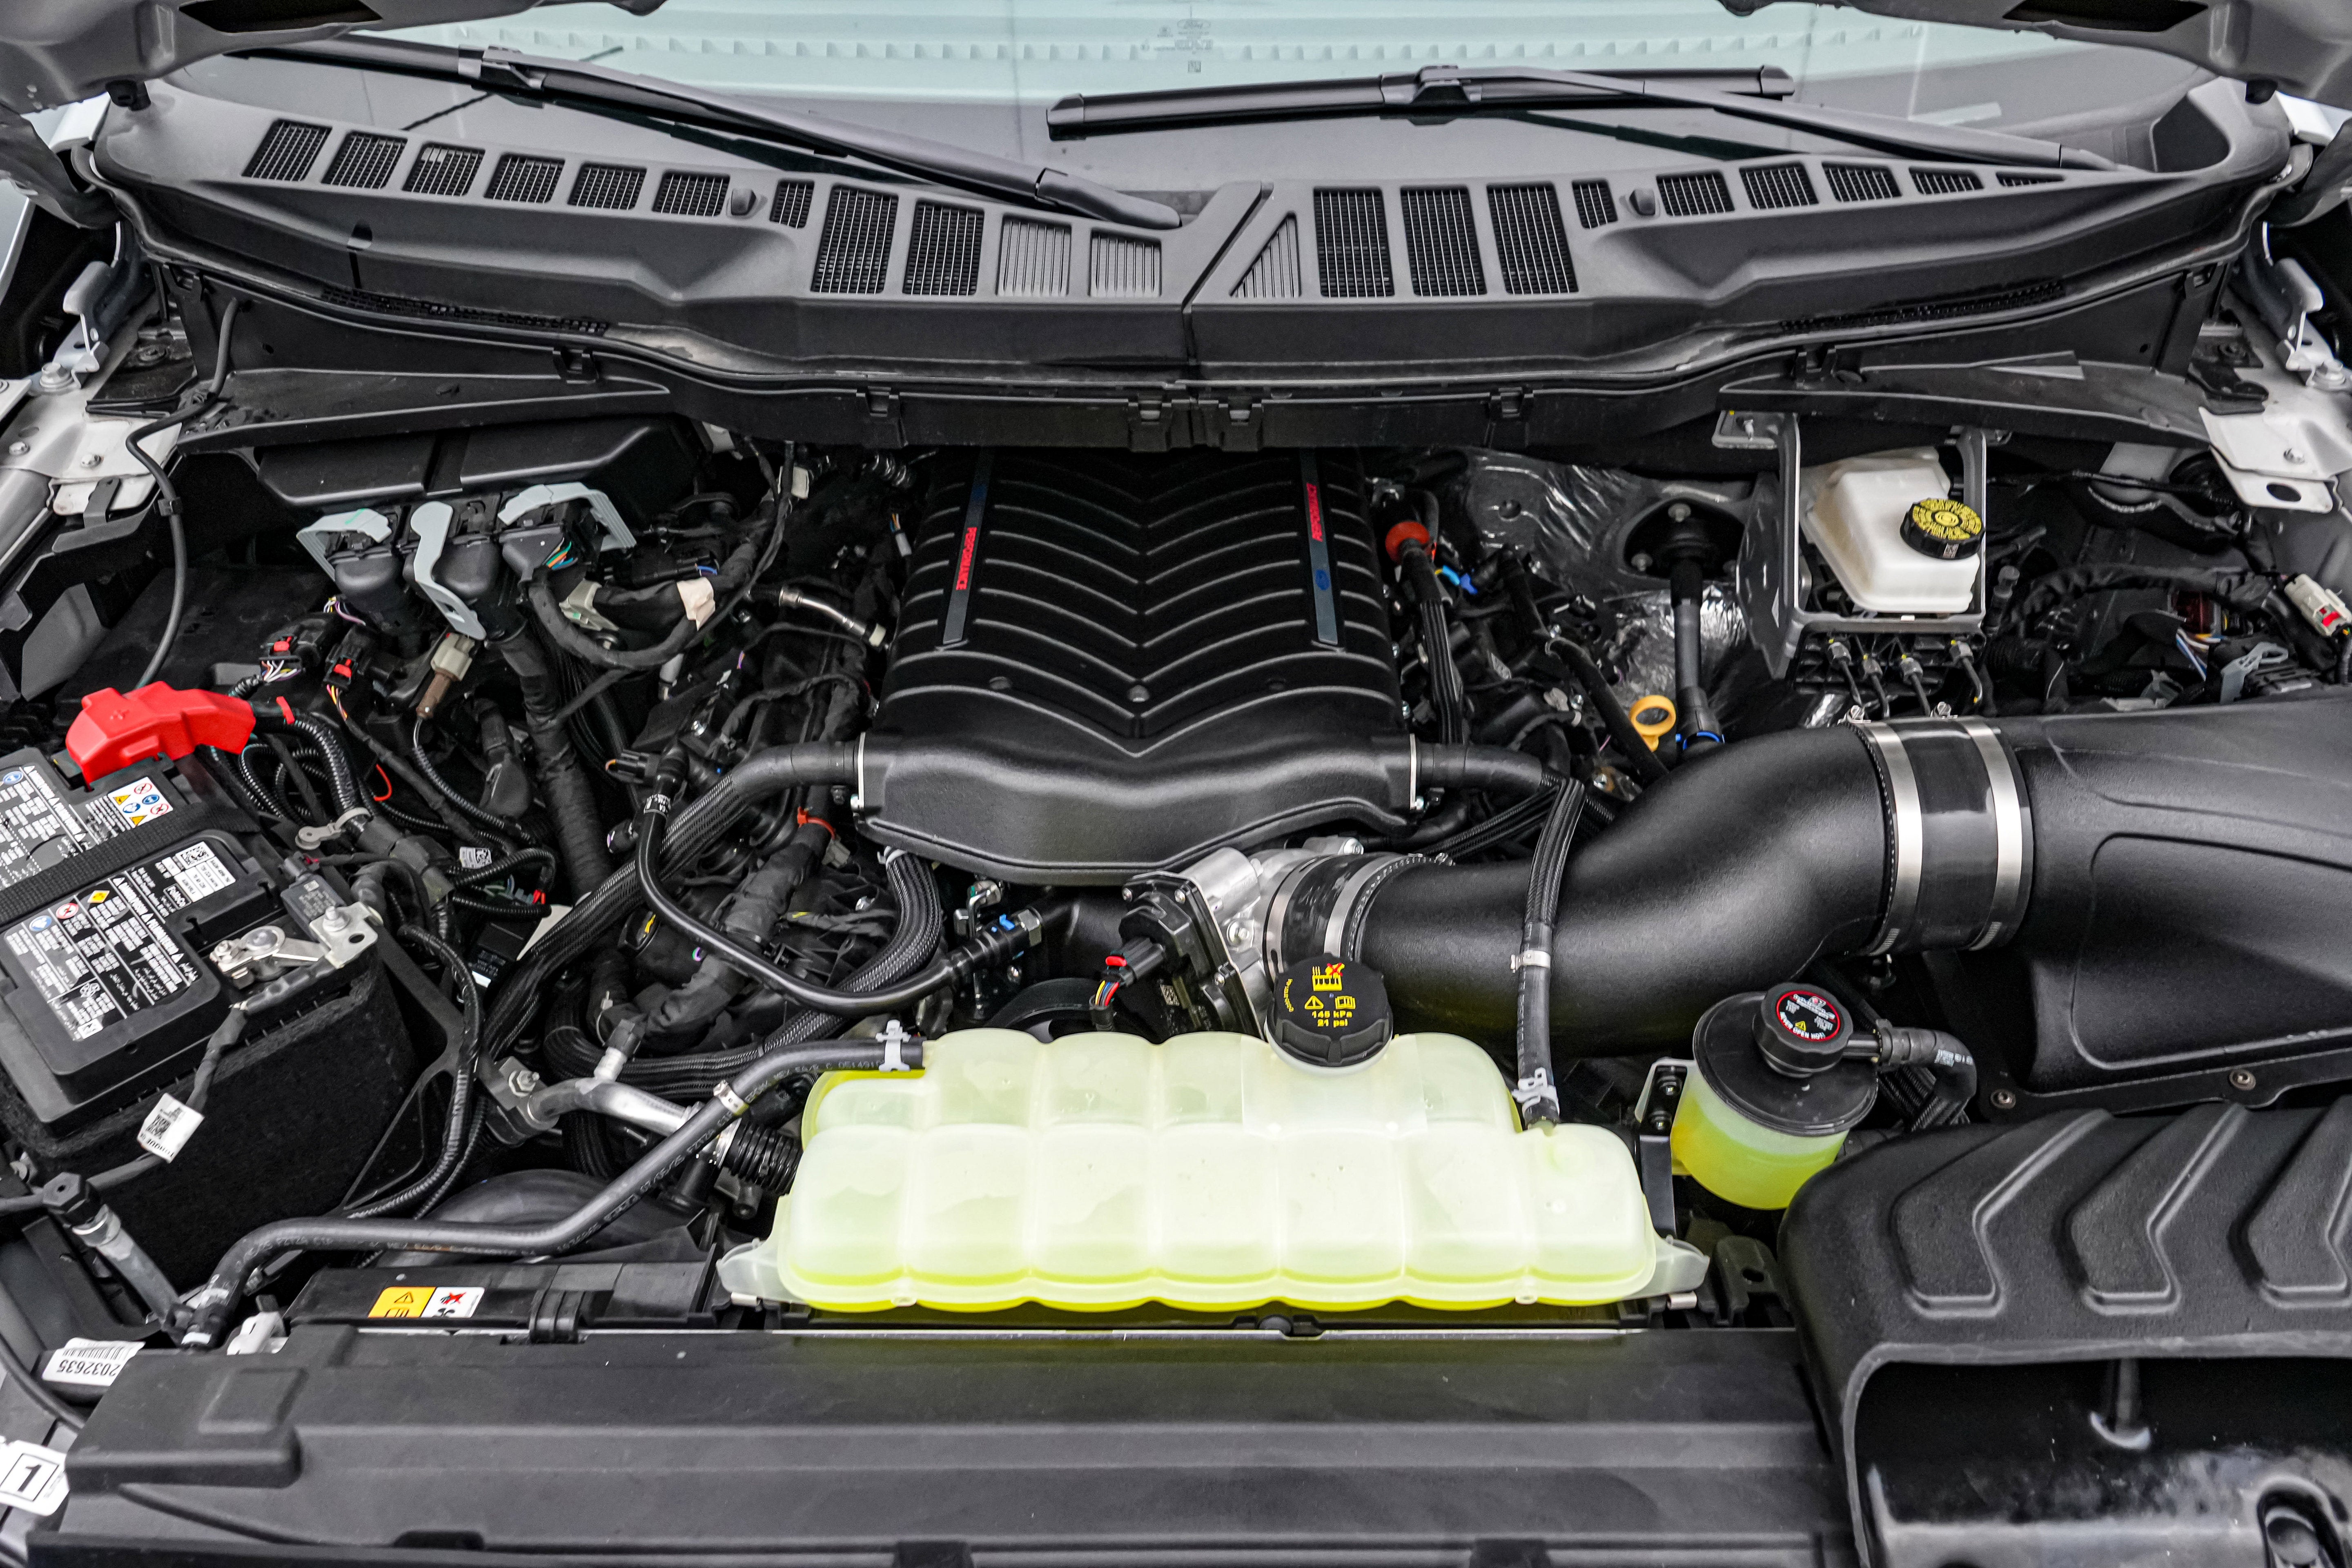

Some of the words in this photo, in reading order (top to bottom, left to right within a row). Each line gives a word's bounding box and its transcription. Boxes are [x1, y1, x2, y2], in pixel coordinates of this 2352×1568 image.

[1318, 1019, 1329, 1027] 21
[1333, 1019, 1348, 1027] psi
[1780, 1011, 1793, 1029] NEVER
[1793, 1027, 1809, 1038] OPEN
[57, 1360, 121, 1376] 2032635
[17, 1464, 41, 1492] 1
